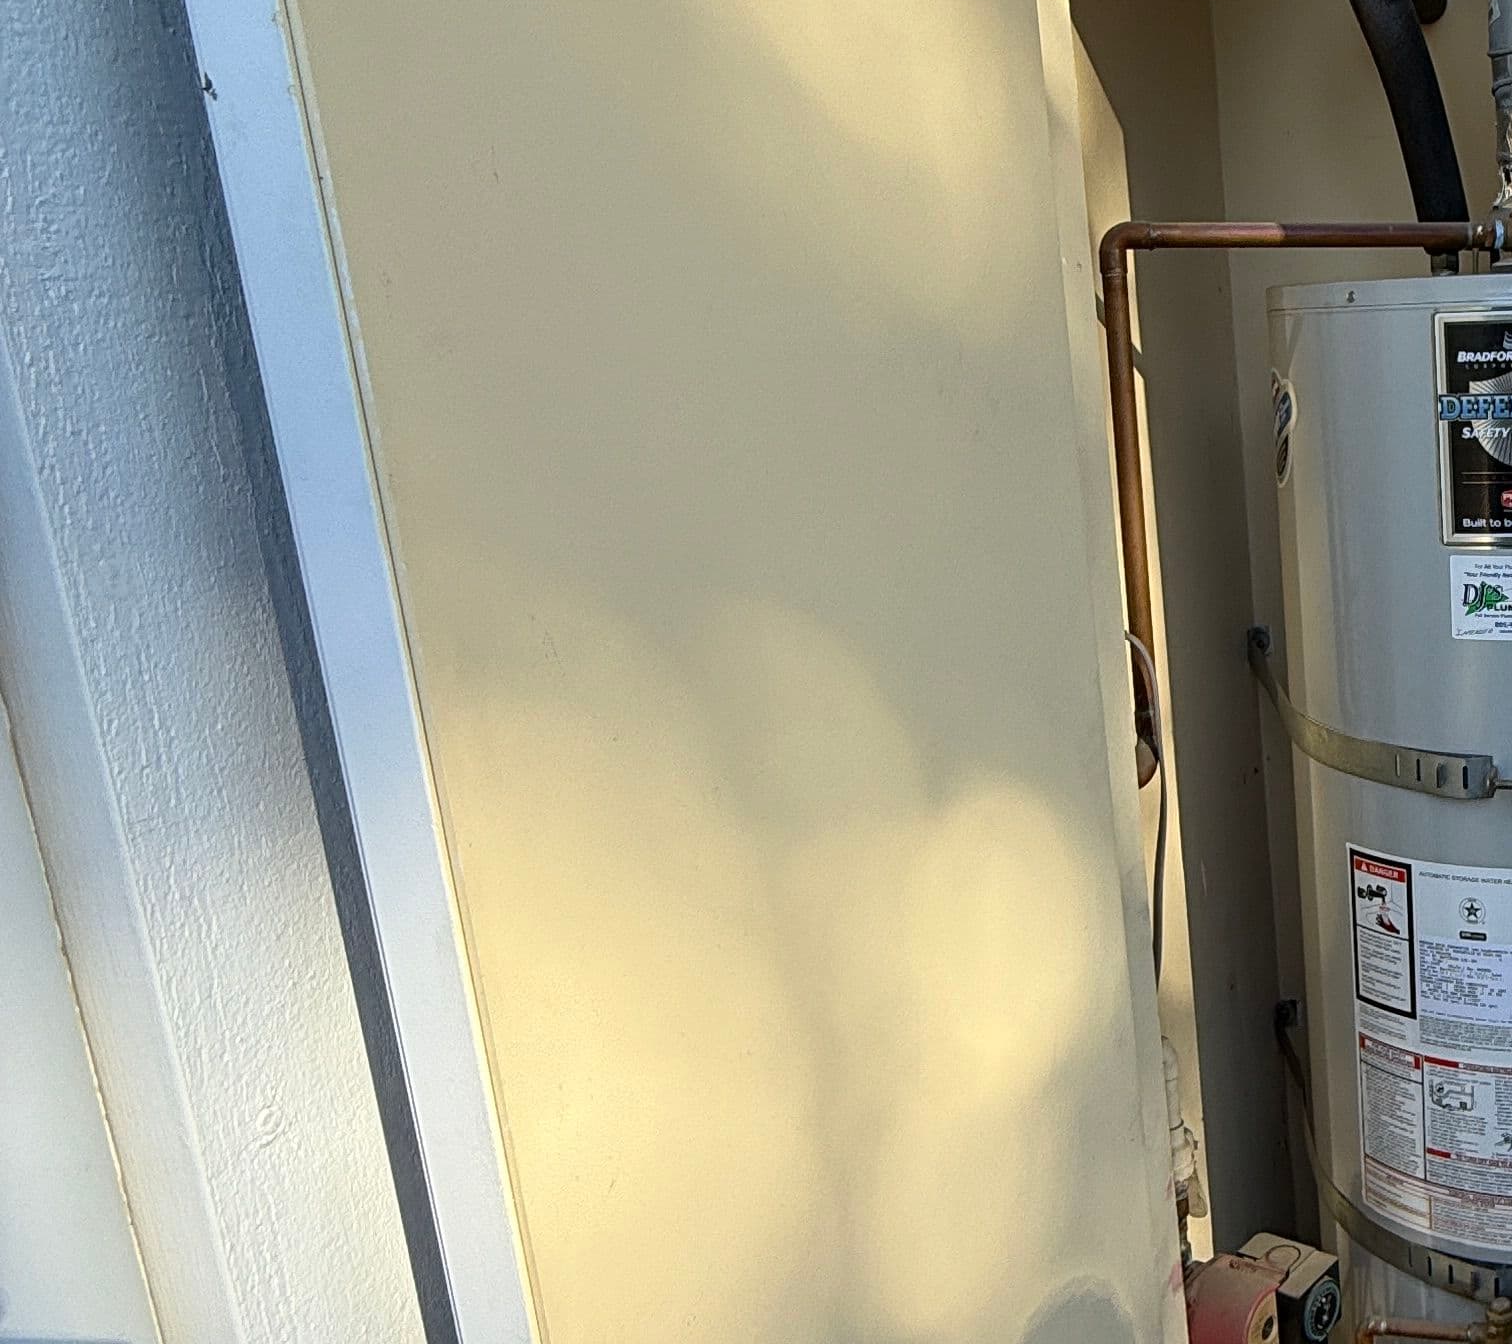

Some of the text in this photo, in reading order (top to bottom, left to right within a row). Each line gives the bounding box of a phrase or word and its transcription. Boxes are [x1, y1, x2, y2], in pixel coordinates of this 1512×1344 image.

[1462, 427, 1510, 439] SAFETY
[1463, 518, 1487, 528] Built
[1489, 519, 1501, 528] to
[1451, 875, 1479, 883] STORAGE
